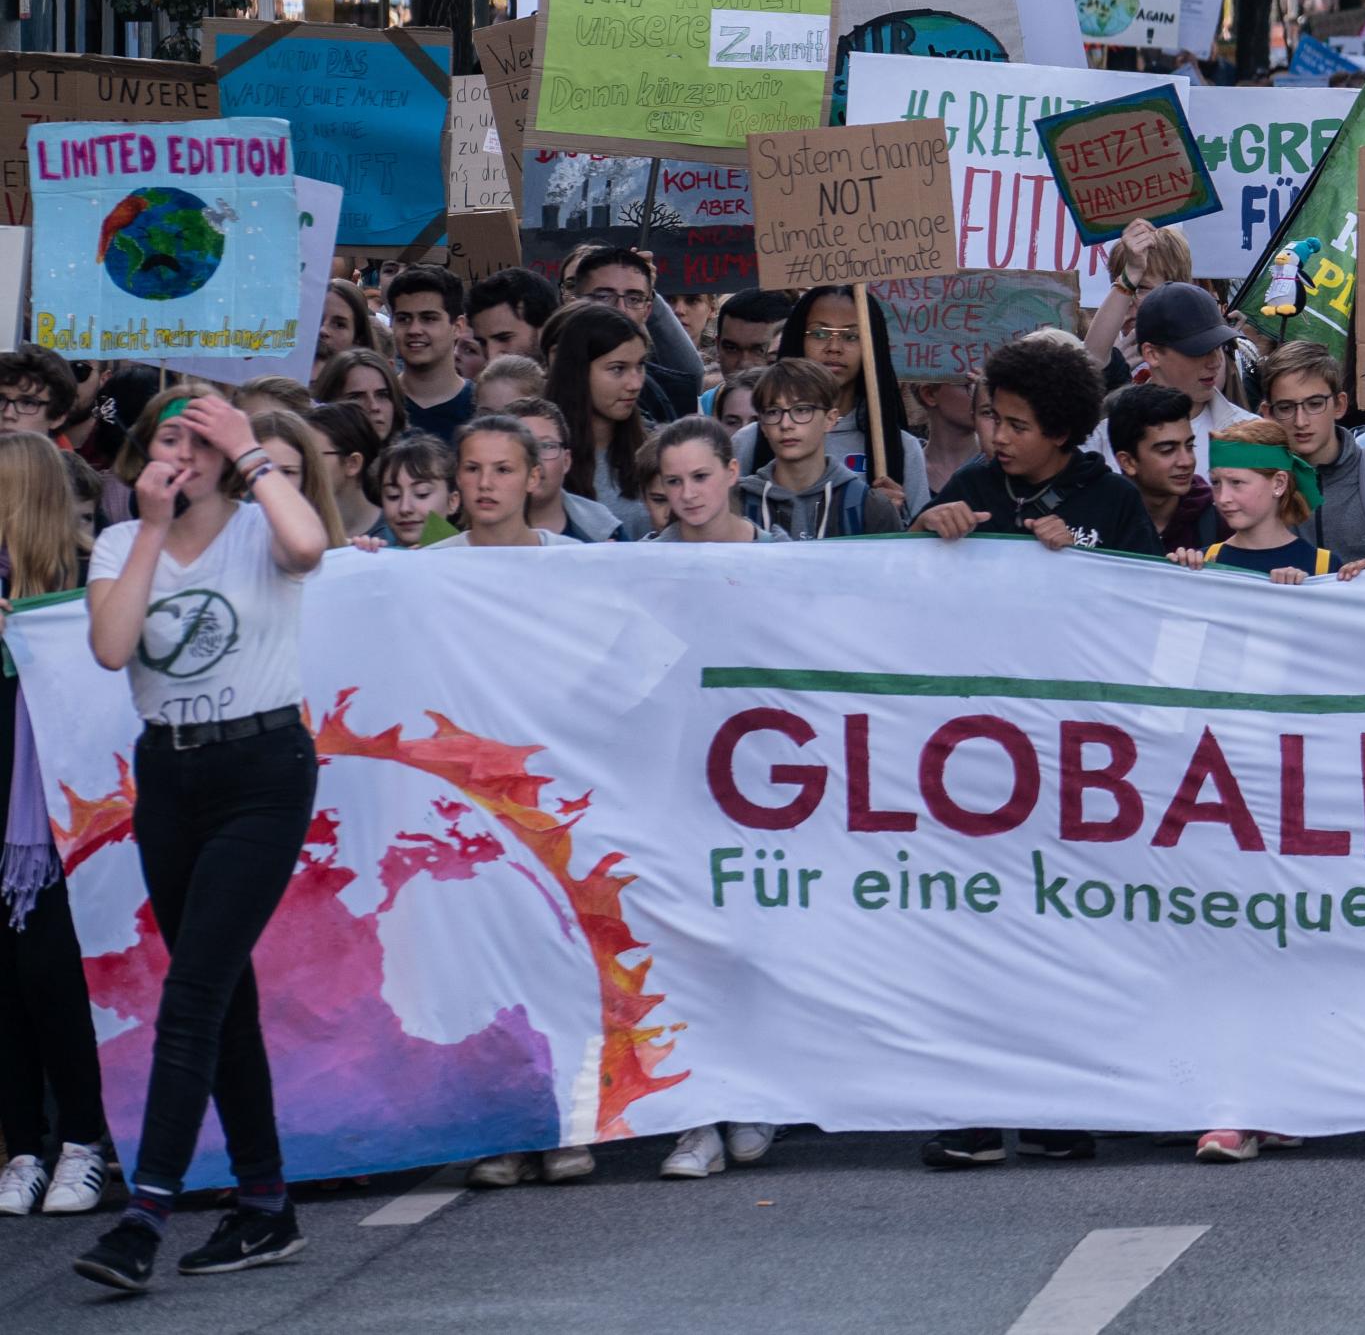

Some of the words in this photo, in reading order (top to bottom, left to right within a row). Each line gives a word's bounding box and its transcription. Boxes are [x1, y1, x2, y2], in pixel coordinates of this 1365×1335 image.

[1136, 9, 1175, 24] AGAIN
[576, 14, 712, 50] unsere
[716, 25, 828, 64] Zukunft!
[326, 47, 369, 77] DAS
[13, 70, 64, 101] IST
[98, 74, 209, 109] UNSERE
[224, 83, 264, 107] WAS
[266, 85, 289, 106] DIE
[294, 82, 346, 108] SCHULE
[352, 86, 410, 108] MACHEN
[551, 74, 629, 114] Dann
[636, 71, 734, 107] kürzen
[736, 72, 784, 102] wir
[646, 110, 705, 134] eure
[726, 100, 815, 138] Renten
[37, 132, 157, 180] LIMITED
[167, 135, 289, 178] EDITION
[757, 137, 853, 196] System
[860, 128, 949, 186] change
[1059, 119, 1171, 174] JETZT!
[663, 168, 749, 194] KOHLE,
[818, 175, 883, 217] NOT
[1075, 167, 1190, 216] HANDELN
[696, 198, 750, 216] ABER
[758, 216, 848, 255] climate
[857, 213, 950, 253] change
[867, 276, 934, 301] RAISE
[941, 274, 999, 304] YOUR
[37, 312, 95, 351] Bald
[101, 317, 151, 352] nicht
[154, 318, 199, 348] mehr
[891, 303, 985, 334] VOICE
[904, 342, 943, 369] THE
[157, 686, 236, 727] STOP
[710, 846, 822, 910] Für
[852, 852, 1000, 914] eine
